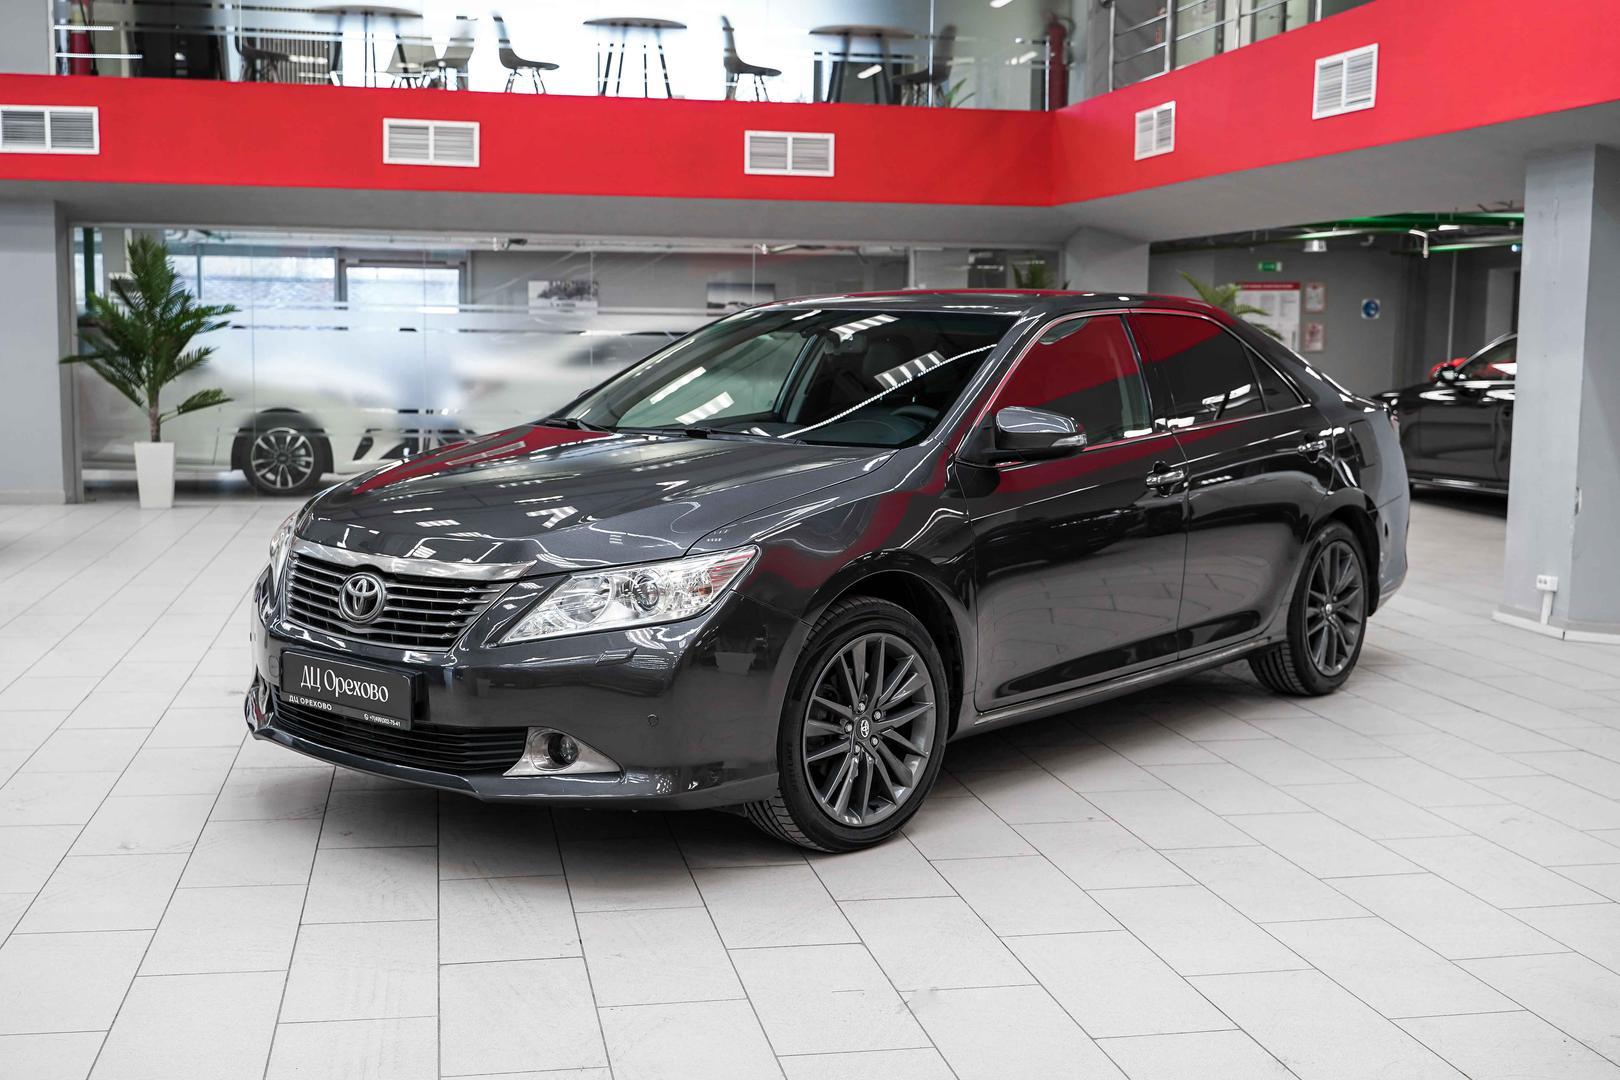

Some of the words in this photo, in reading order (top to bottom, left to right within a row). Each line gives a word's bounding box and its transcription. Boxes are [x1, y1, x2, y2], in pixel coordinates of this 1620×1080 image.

[300, 665, 321, 692] ДЦ
[324, 669, 388, 702] Орехово
[289, 695, 299, 703] ДЦ
[300, 697, 332, 710] ОРЕХОВО
